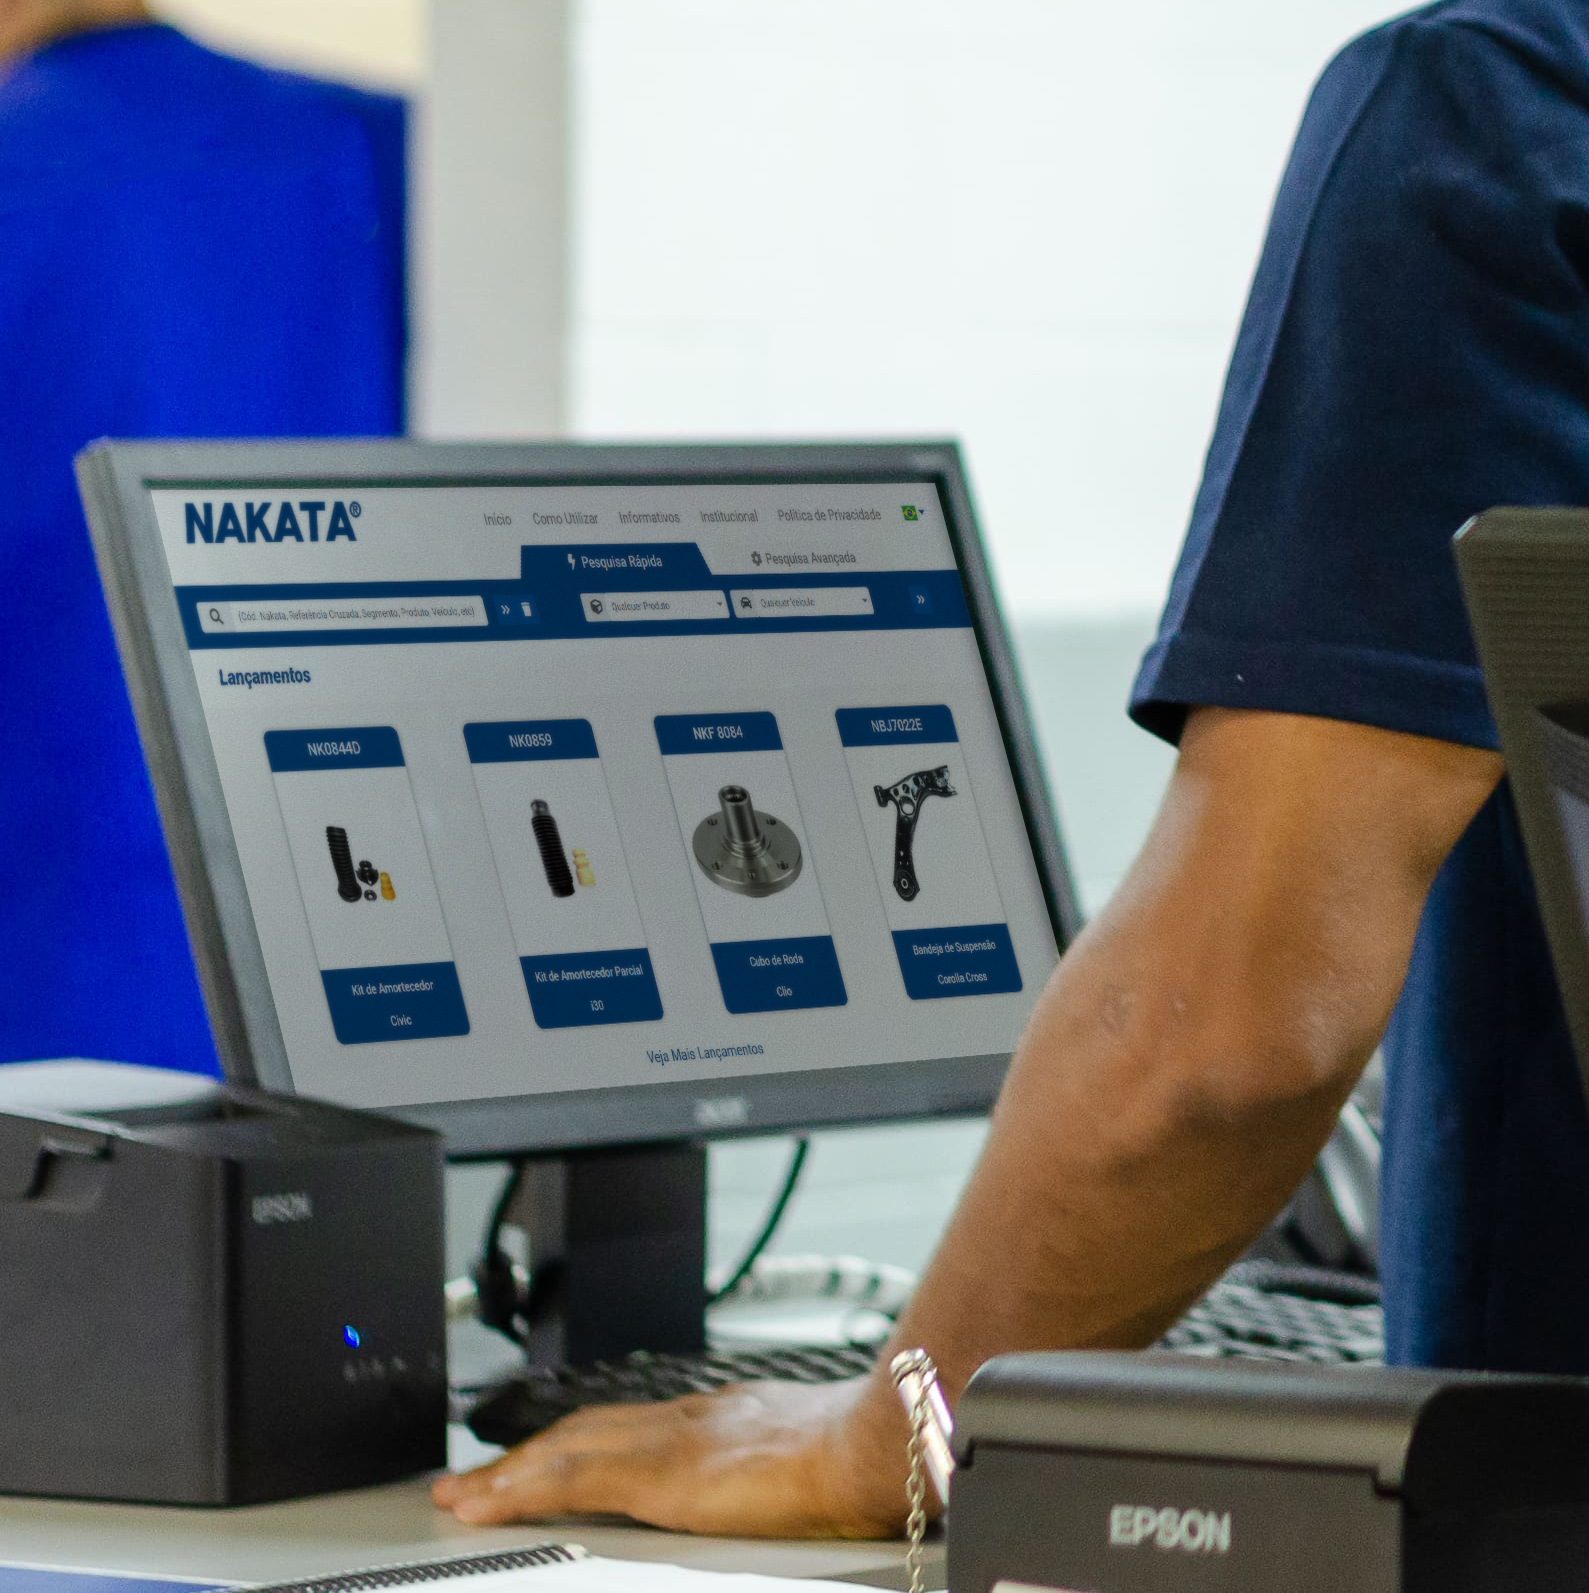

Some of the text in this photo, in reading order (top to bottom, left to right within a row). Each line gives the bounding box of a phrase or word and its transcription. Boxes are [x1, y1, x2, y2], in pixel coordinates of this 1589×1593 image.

[484, 512, 513, 526] Início
[532, 511, 599, 525] Como Utilizar
[618, 511, 681, 524] Informativos
[699, 510, 759, 523] Institucional
[814, 509, 827, 521] de
[827, 508, 882, 521] Privacidade
[580, 554, 663, 572] Pesquisa Rápida
[764, 551, 857, 567] Pesquisa Avançada
[219, 667, 312, 690] Lançamentos
[692, 725, 744, 740] NKF 8084
[870, 718, 924, 733] NBJ7022E
[508, 733, 553, 748] NK0859
[307, 741, 362, 757] NK0844D
[912, 939, 997, 956] Bandeja de Suspensão
[749, 953, 804, 967] Cubo de Roda
[534, 964, 644, 983] Kit de Amortecedor Parcial
[937, 972, 988, 985] Corolla Cross
[351, 979, 434, 997] Kit de Amortecedor
[776, 986, 793, 997] Clio
[590, 999, 605, 1011] i30
[390, 1014, 413, 1027] Civic
[646, 1043, 765, 1067] Veja Mais Lançamentos
[1109, 1504, 1232, 1554] EPSON
